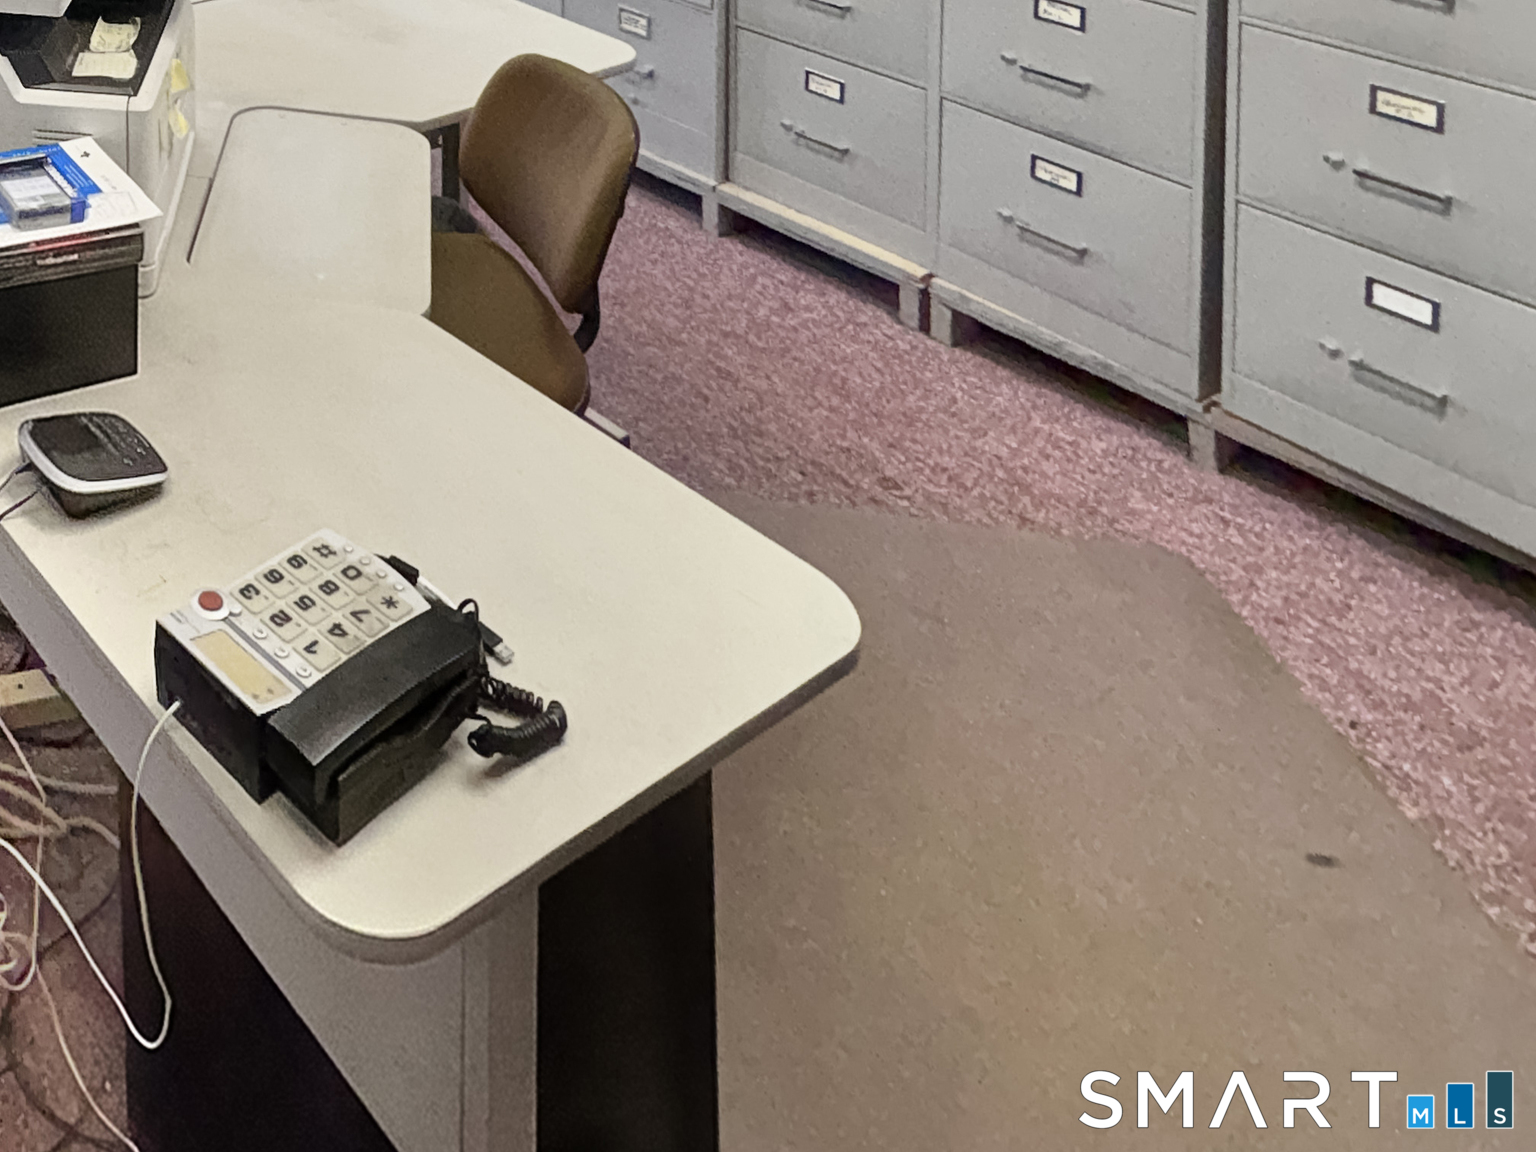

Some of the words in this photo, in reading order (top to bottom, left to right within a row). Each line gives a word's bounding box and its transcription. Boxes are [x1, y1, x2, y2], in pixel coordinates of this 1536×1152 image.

[286, 554, 308, 569] 9
[263, 568, 285, 584] 6
[340, 565, 362, 581] 0
[238, 583, 261, 600] 3
[318, 579, 340, 596] 8
[293, 594, 316, 611] 5
[269, 609, 293, 628] 2
[350, 608, 372, 623] 7
[327, 621, 349, 638] 4
[303, 639, 320, 655] 1
